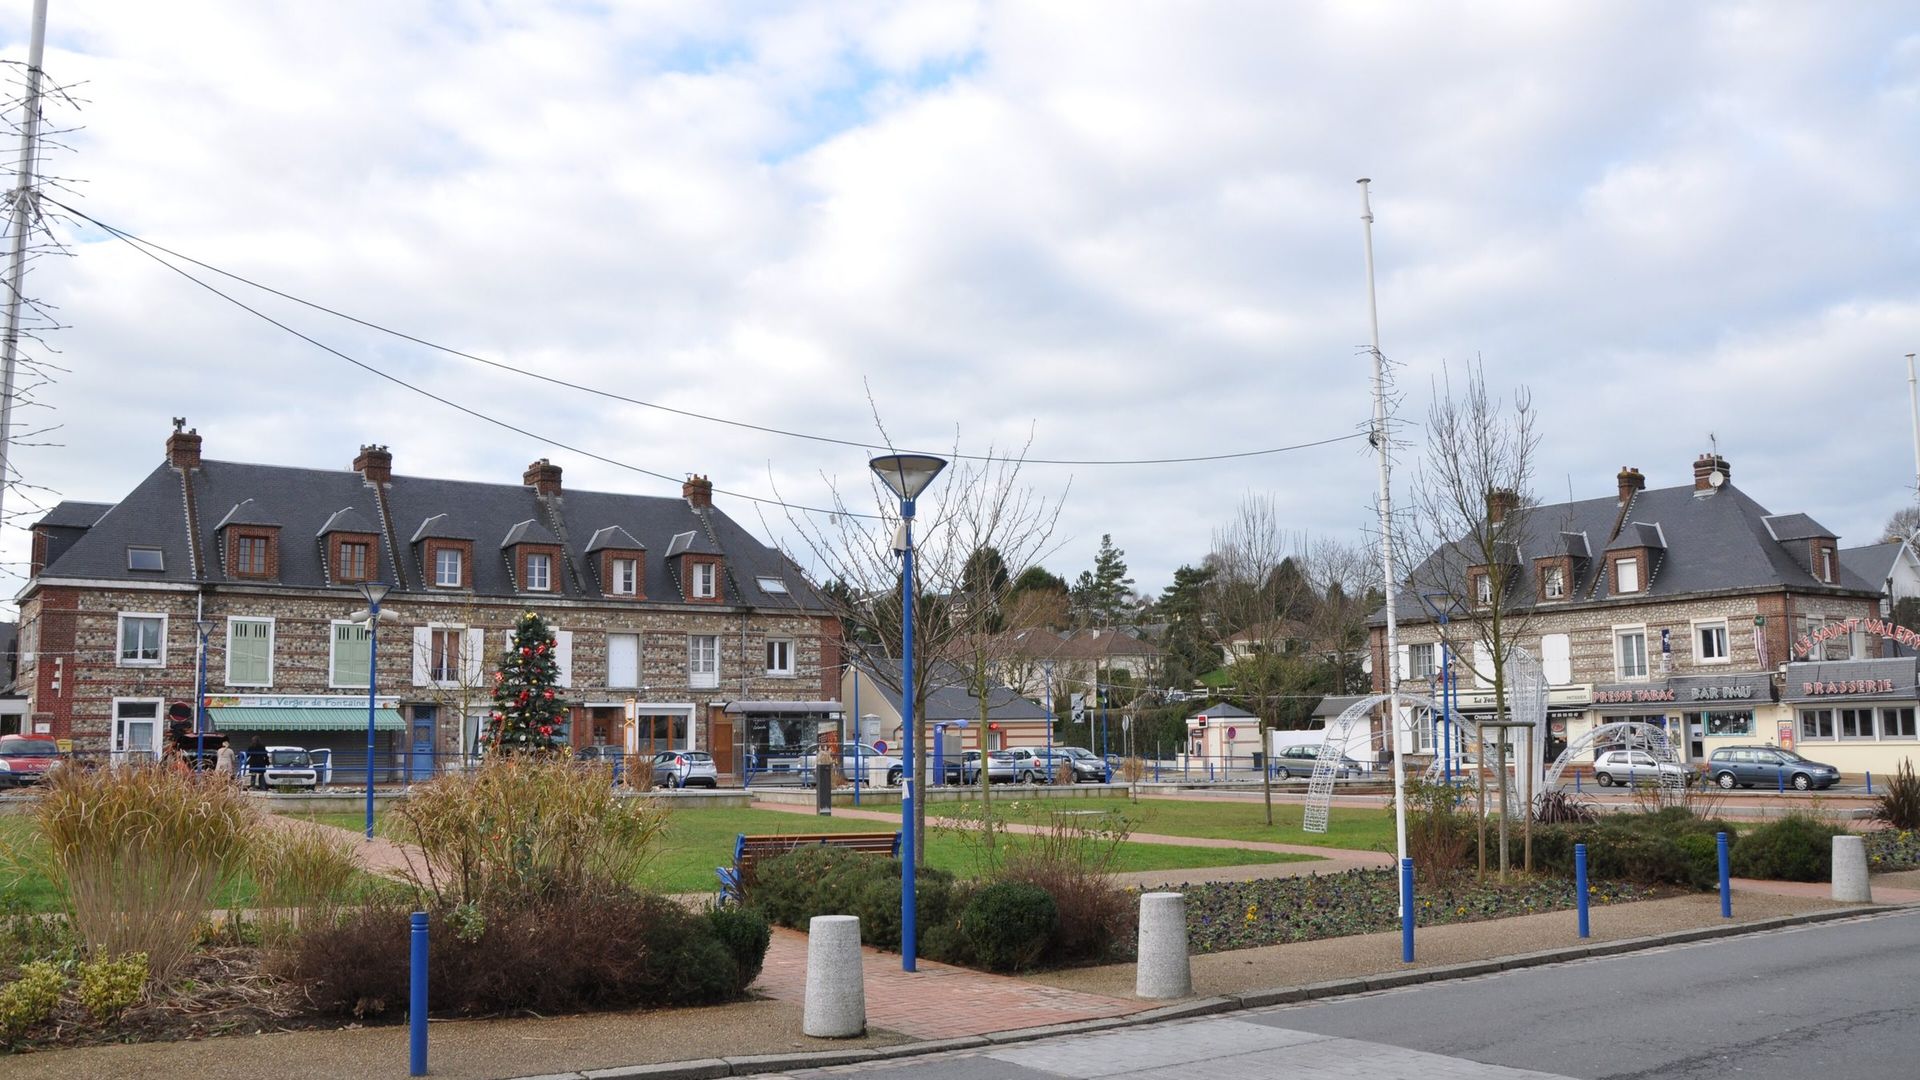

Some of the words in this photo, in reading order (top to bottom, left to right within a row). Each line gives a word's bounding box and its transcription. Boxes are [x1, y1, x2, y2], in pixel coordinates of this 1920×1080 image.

[1793, 634, 1814, 657] LE
[1811, 617, 1860, 642] SAINT
[1863, 617, 1920, 650] VALERY
[1691, 687, 1719, 700] BAR
[1722, 685, 1751, 699] PMU
[1803, 679, 1893, 695] BRASSERIE
[259, 696, 273, 706] Le
[275, 696, 309, 708] Verger
[311, 697, 322, 706] de
[325, 697, 367, 707] Fontaine
[1592, 689, 1633, 704] PRESSE
[1635, 688, 1676, 702] TABAC
